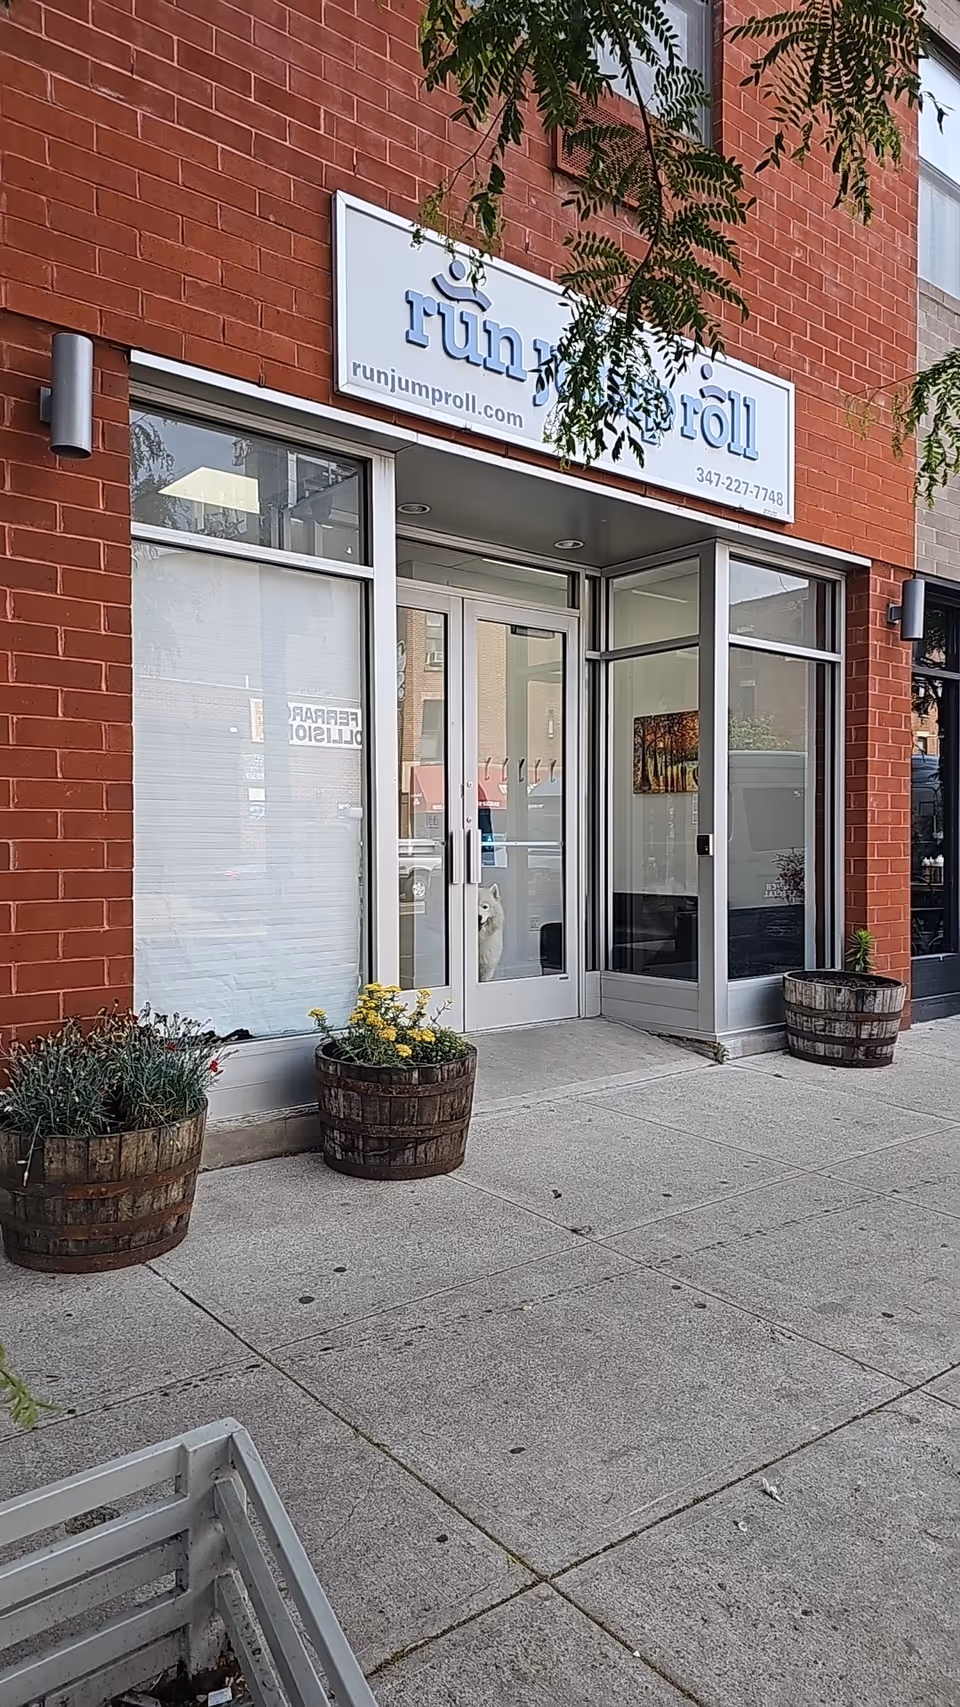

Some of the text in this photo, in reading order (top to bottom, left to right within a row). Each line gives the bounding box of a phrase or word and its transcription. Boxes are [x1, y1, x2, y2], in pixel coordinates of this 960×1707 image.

[352, 361, 523, 428] runjumproll.com
[405, 289, 758, 461] run jp roll
[696, 466, 784, 507] 347-227-7748
